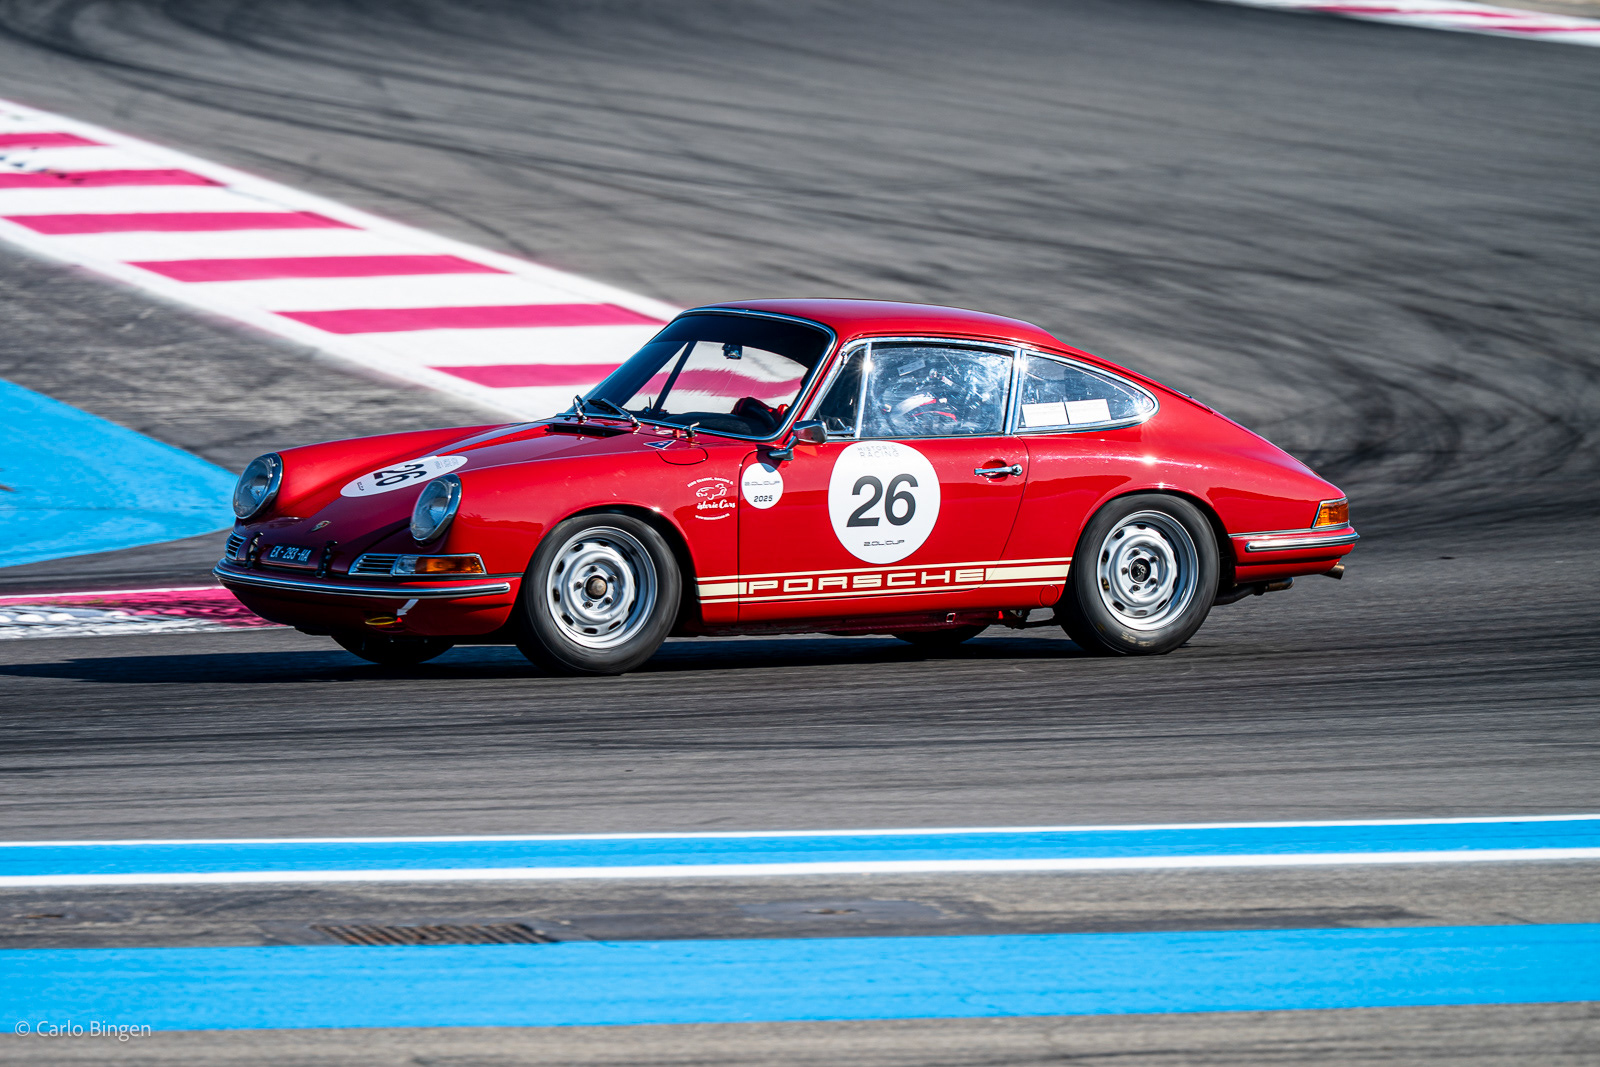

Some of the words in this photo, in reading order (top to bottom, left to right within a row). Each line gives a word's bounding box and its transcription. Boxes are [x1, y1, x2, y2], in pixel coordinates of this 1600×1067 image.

[373, 463, 427, 486] 26
[719, 499, 736, 508] Cars
[847, 473, 919, 527] 26
[748, 568, 984, 594] PORSCHE
